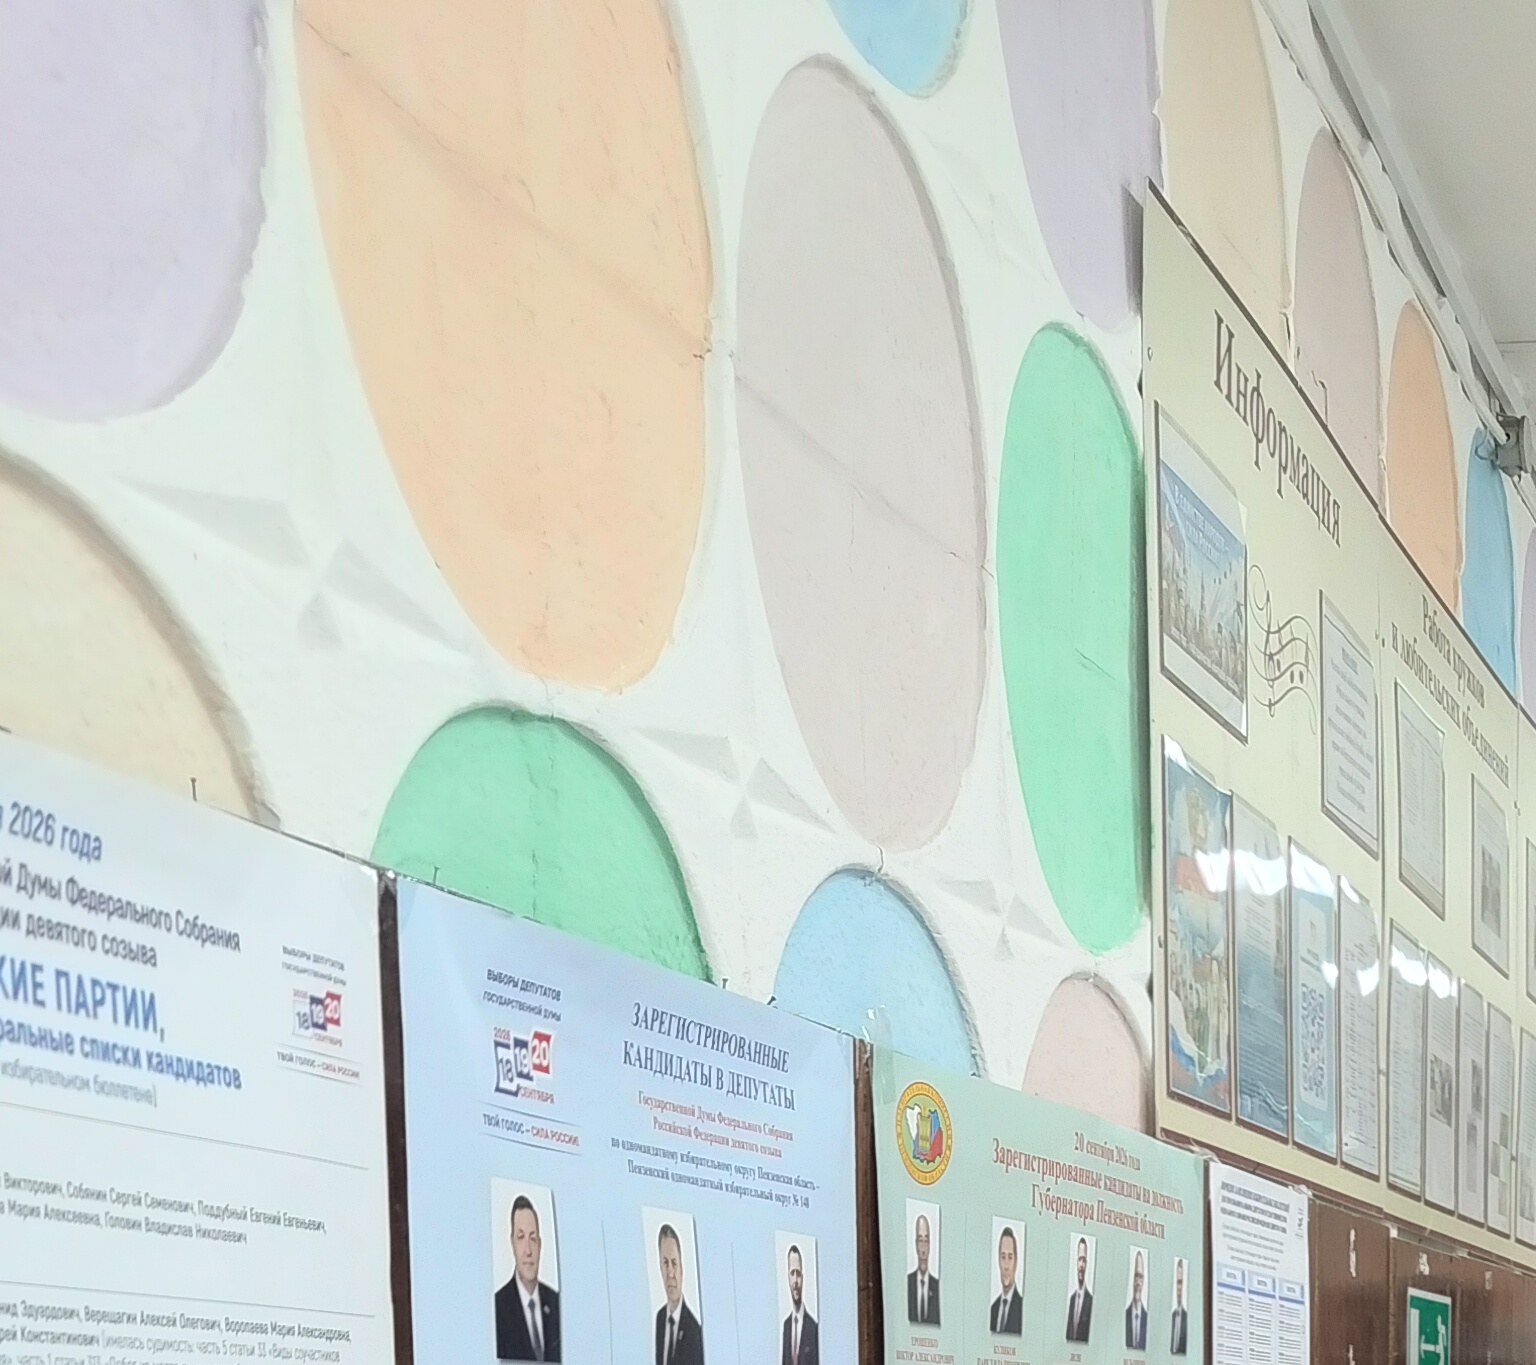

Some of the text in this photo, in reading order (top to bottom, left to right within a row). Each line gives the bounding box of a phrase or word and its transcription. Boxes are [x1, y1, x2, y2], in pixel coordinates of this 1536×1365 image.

[1214, 308, 1341, 548] Информация
[1422, 594, 1451, 666] Работа
[1400, 634, 1461, 730] любительских
[9, 801, 103, 863] 2026 года
[17, 862, 61, 901] Думы
[65, 876, 172, 932] Федерального
[175, 909, 242, 952] Собрания
[25, 912, 97, 952] девятого
[101, 933, 157, 968] созыва
[55, 968, 165, 1042] ПАРТИИ,
[325, 997, 340, 1020] 20
[486, 968, 561, 1002] ВЫБОРЫ ДЕПУТАТОВ
[296, 1011, 310, 1031] 18
[631, 1002, 790, 1073] ЗАРЕГИСТРИРОВАННЫЕ
[1, 1058, 91, 1092] избирательном
[80, 1035, 141, 1070] списки
[146, 1049, 242, 1090] кандидатов
[499, 1058, 514, 1084] 18
[514, 1046, 530, 1075] 19
[532, 1038, 549, 1066] 20
[623, 1040, 796, 1111] КАНДИДАТЫ В ДЕПУТАТЫ
[638, 1090, 793, 1141] Государственной Думы Федерального Собрания
[653, 1116, 782, 1158] Российской Федерации девятого созыва
[1074, 1131, 1085, 1151] 20
[992, 1138, 1102, 1189] Зарегистрированные
[1031, 1183, 1094, 1226] Губернатора
